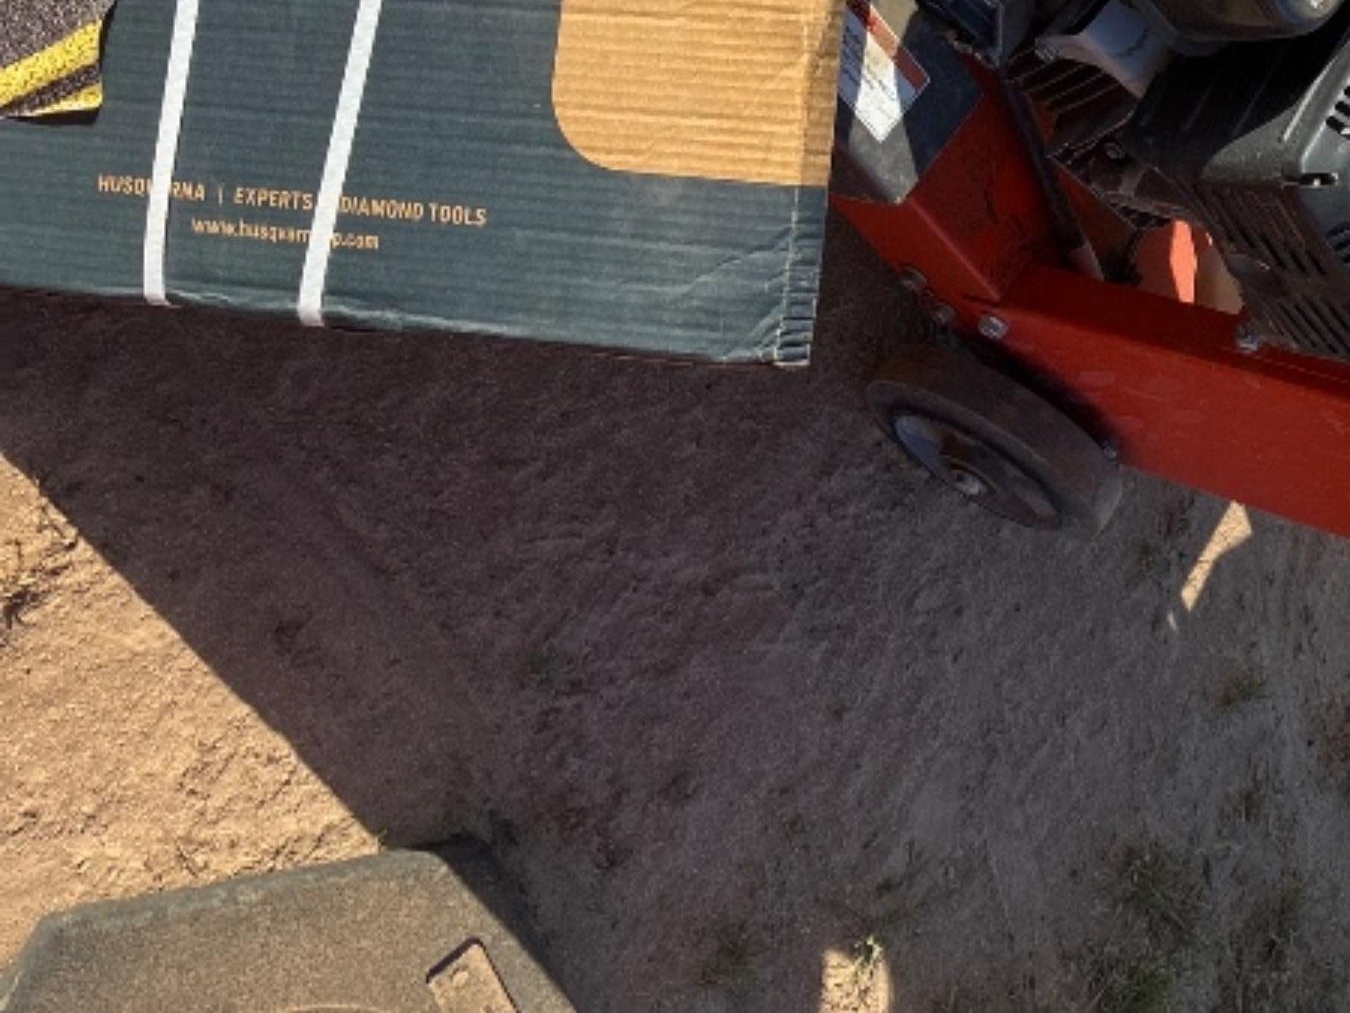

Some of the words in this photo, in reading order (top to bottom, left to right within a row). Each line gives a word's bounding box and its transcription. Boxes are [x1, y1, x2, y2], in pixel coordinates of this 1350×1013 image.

[233, 187, 314, 211] EXPERTS
[340, 195, 424, 221] DIAMOND
[428, 202, 487, 228] TOOLS
